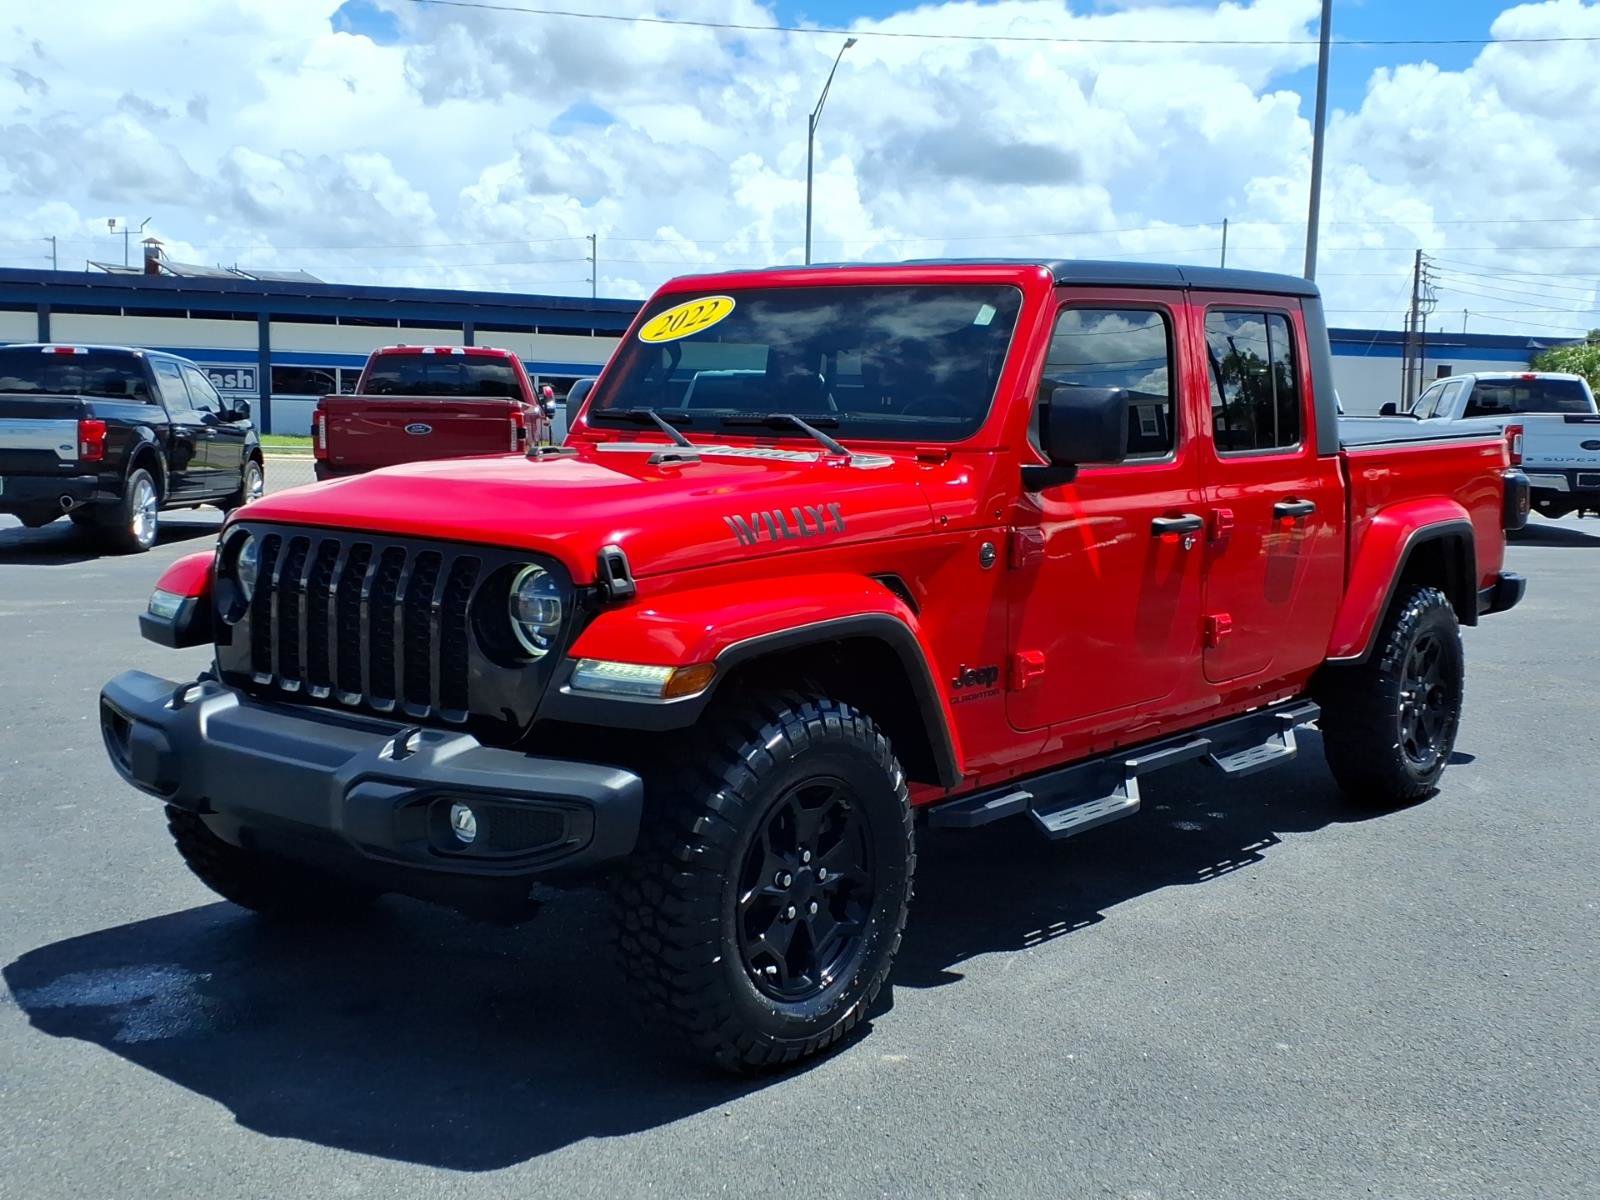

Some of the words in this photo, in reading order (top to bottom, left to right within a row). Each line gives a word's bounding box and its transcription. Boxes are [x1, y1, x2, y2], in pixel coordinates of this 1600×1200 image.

[652, 300, 720, 338] 2022
[202, 368, 253, 389] ash
[723, 502, 846, 546] WILLYS
[952, 663, 1000, 689] Jeep
[950, 688, 1001, 704] GLADIATOR
